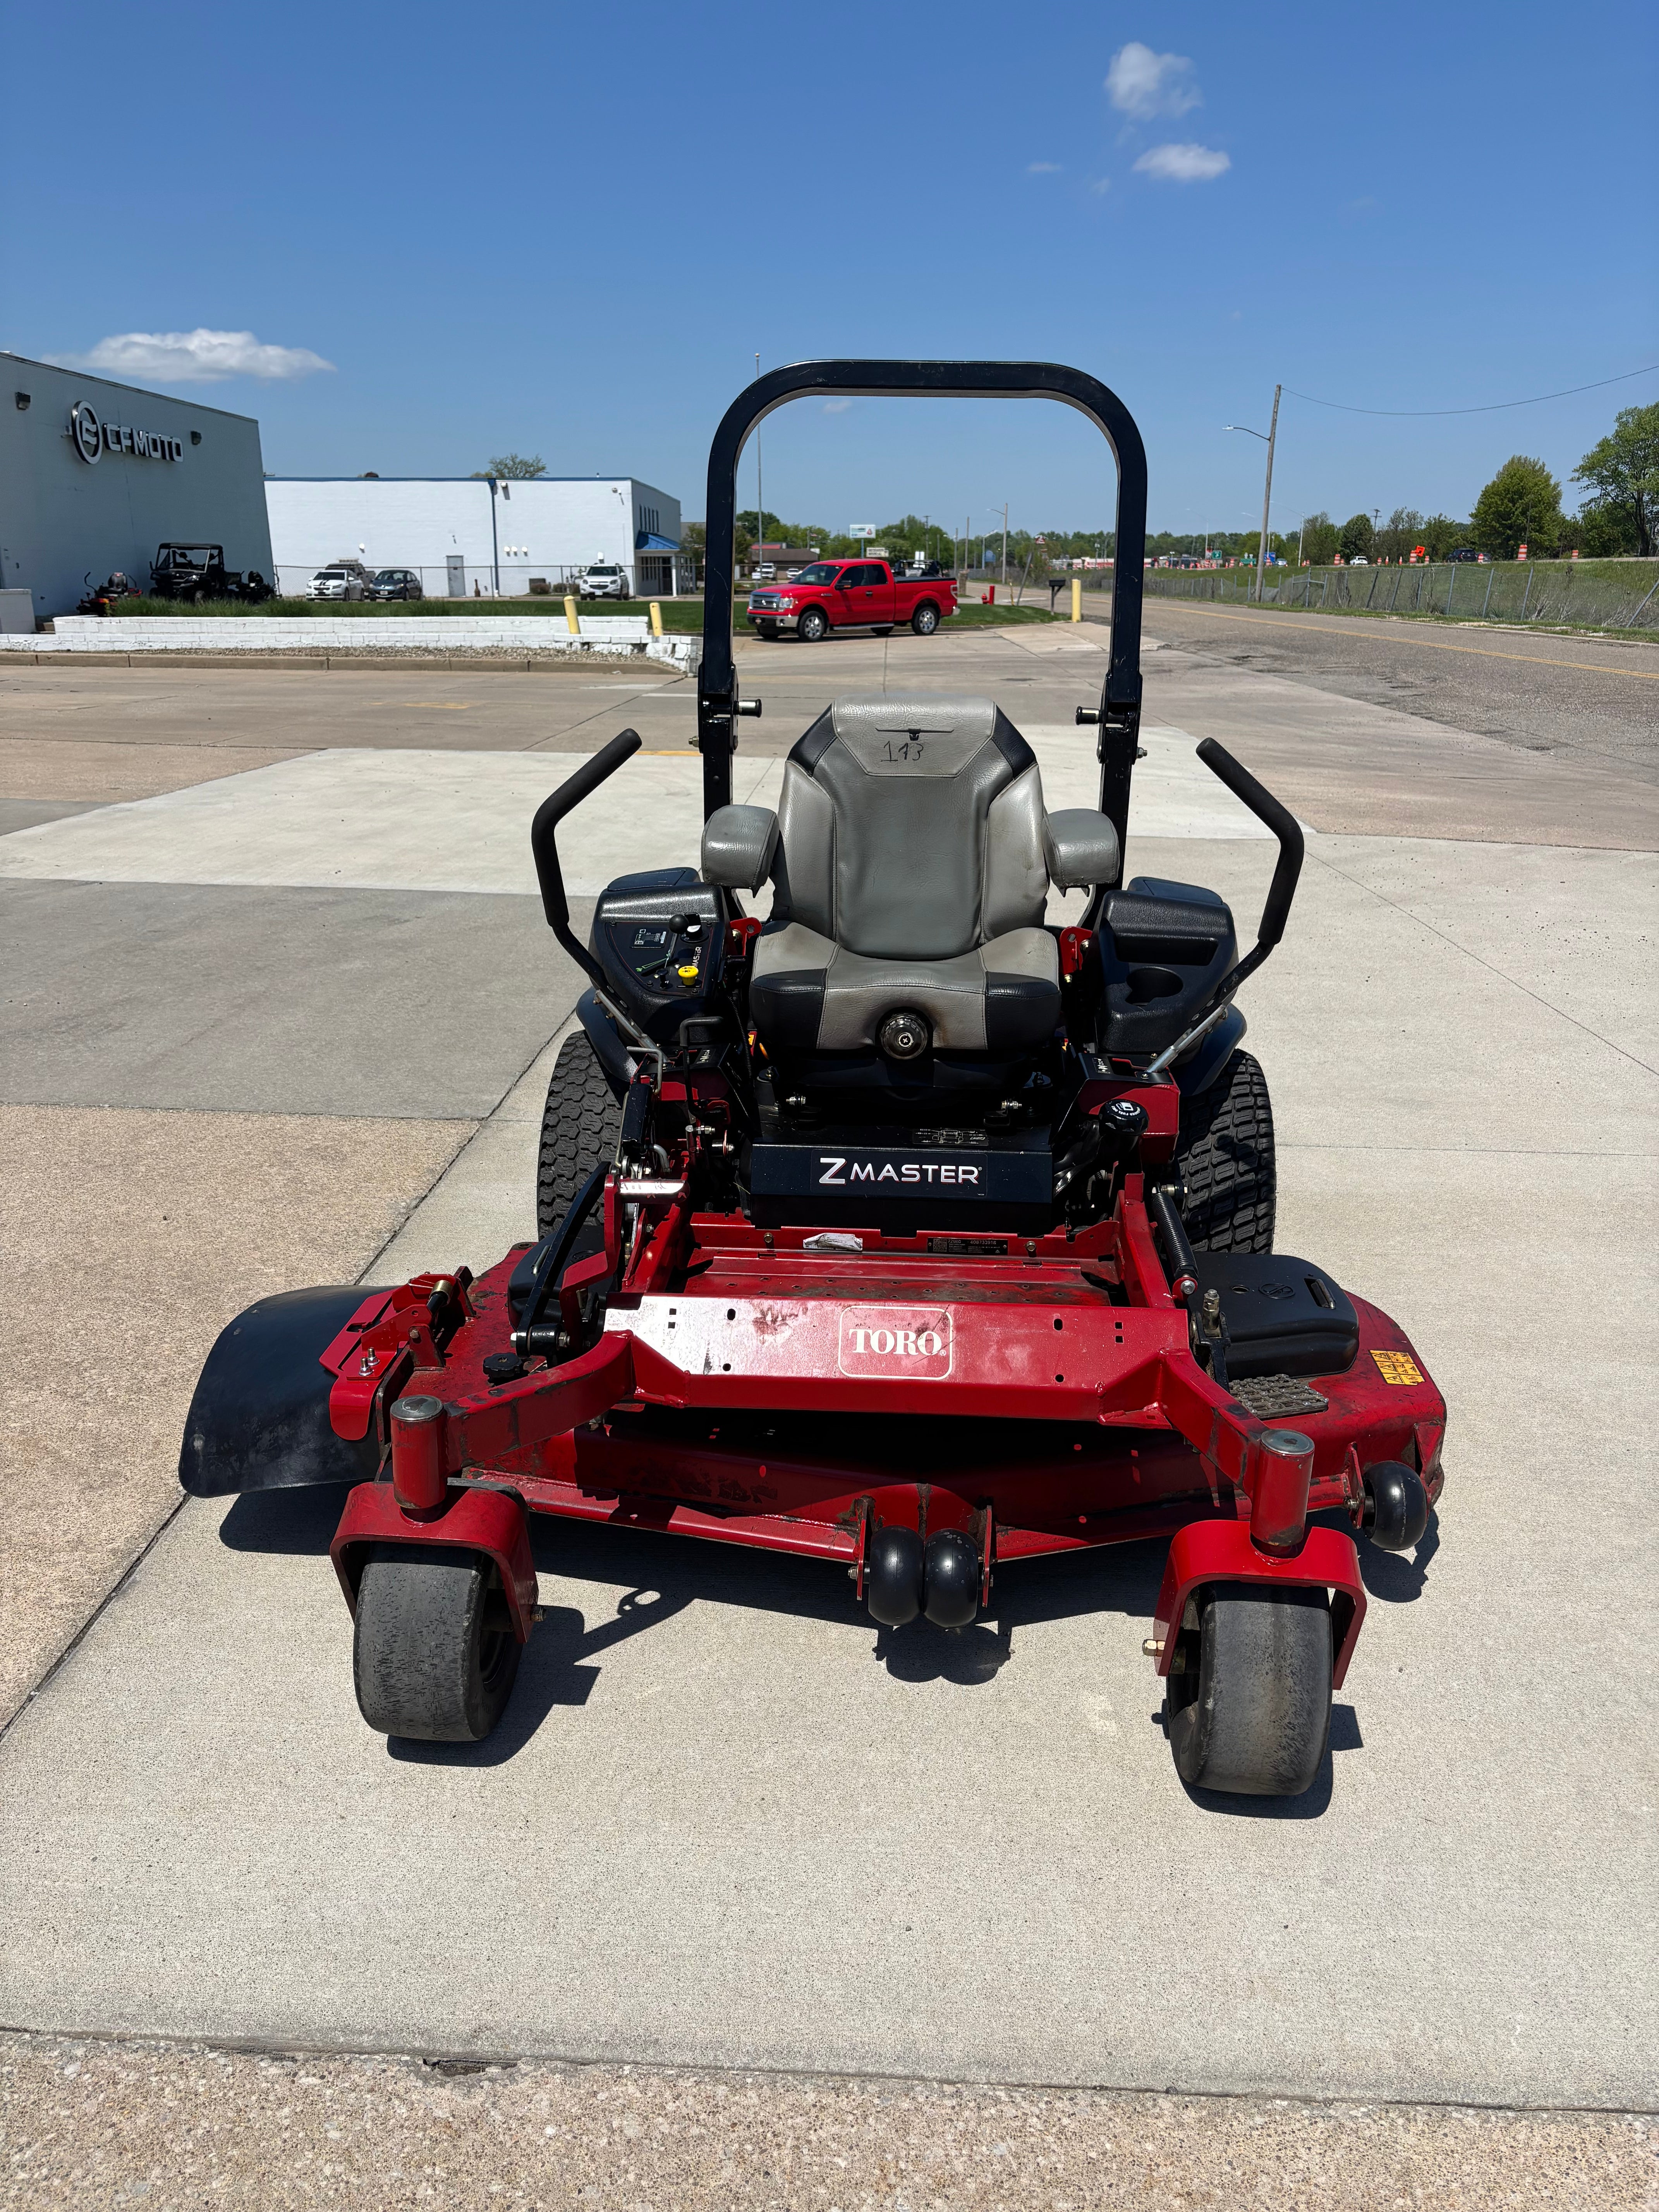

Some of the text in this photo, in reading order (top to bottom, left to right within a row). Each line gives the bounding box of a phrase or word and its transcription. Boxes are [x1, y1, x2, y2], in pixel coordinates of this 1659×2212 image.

[103, 423, 184, 462] CFMOTO
[819, 1158, 980, 1185] Z MASTER
[848, 1328, 942, 1356] TORO
